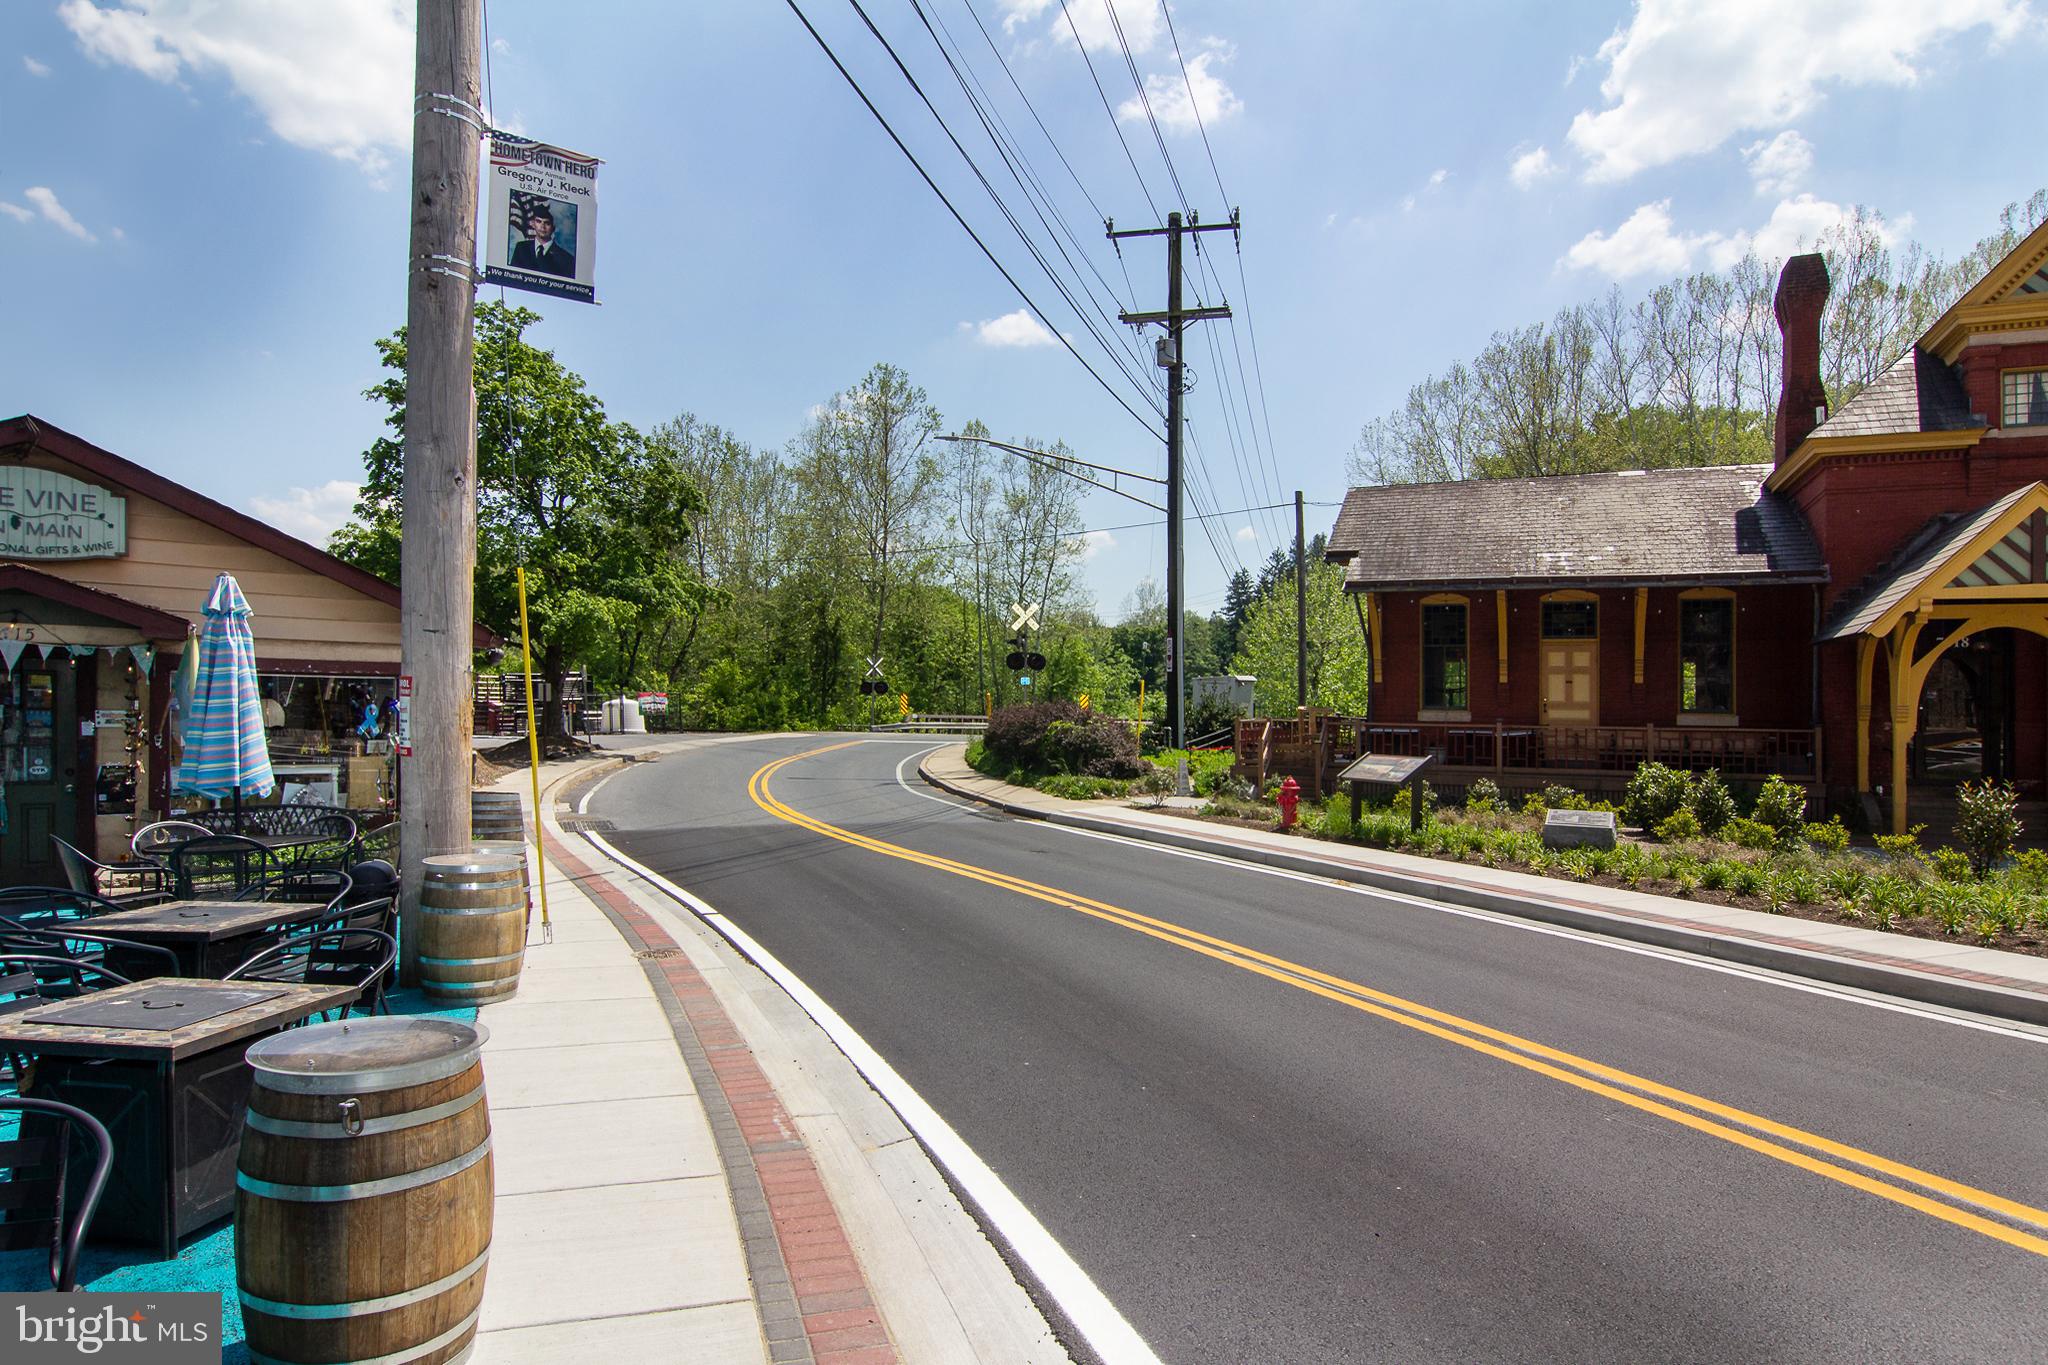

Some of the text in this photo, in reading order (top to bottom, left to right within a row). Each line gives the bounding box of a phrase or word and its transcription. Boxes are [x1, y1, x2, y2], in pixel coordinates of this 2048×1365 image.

[494, 141, 596, 180] HOMETOWN HERO
[498, 166, 591, 196] Gregory J. Kleck
[545, 171, 567, 180] Airman
[520, 183, 569, 200] U.S. Air Force
[491, 268, 503, 276] We
[503, 271, 523, 280] thank
[524, 276, 538, 284] you
[25, 489, 97, 513] VINE
[26, 521, 83, 539] MAIN
[35, 545, 69, 555] GIFTS
[72, 545, 81, 554] &
[82, 540, 114, 552] WINE
